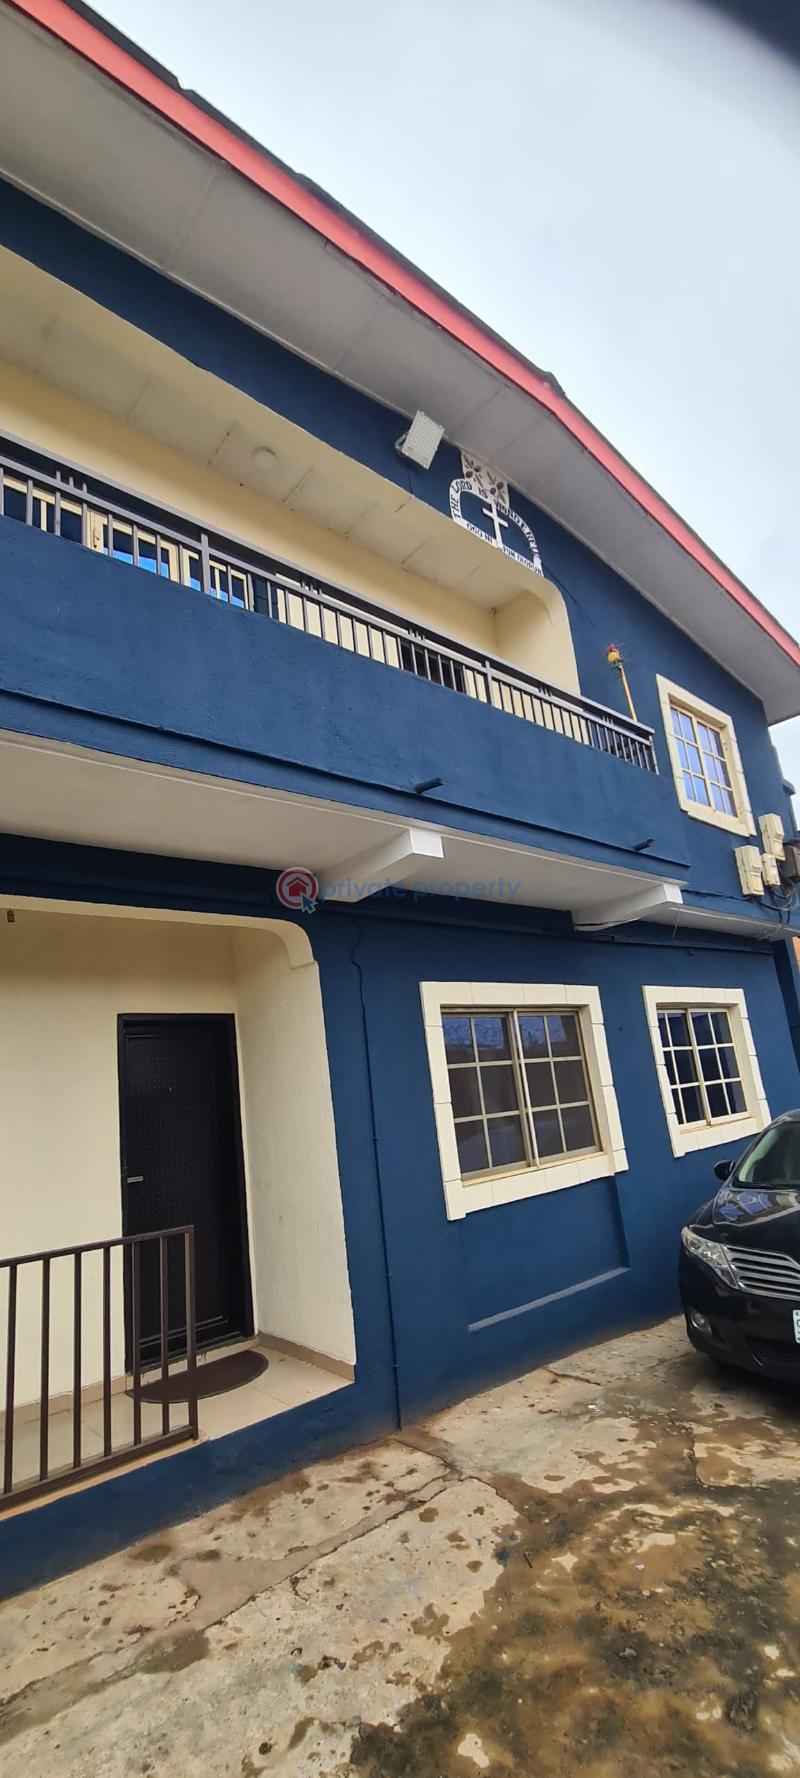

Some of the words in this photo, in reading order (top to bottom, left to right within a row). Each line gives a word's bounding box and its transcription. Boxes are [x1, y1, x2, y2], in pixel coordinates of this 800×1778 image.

[452, 480, 473, 494] LORD
[478, 487, 488, 499] IS
[451, 494, 462, 519] THE
